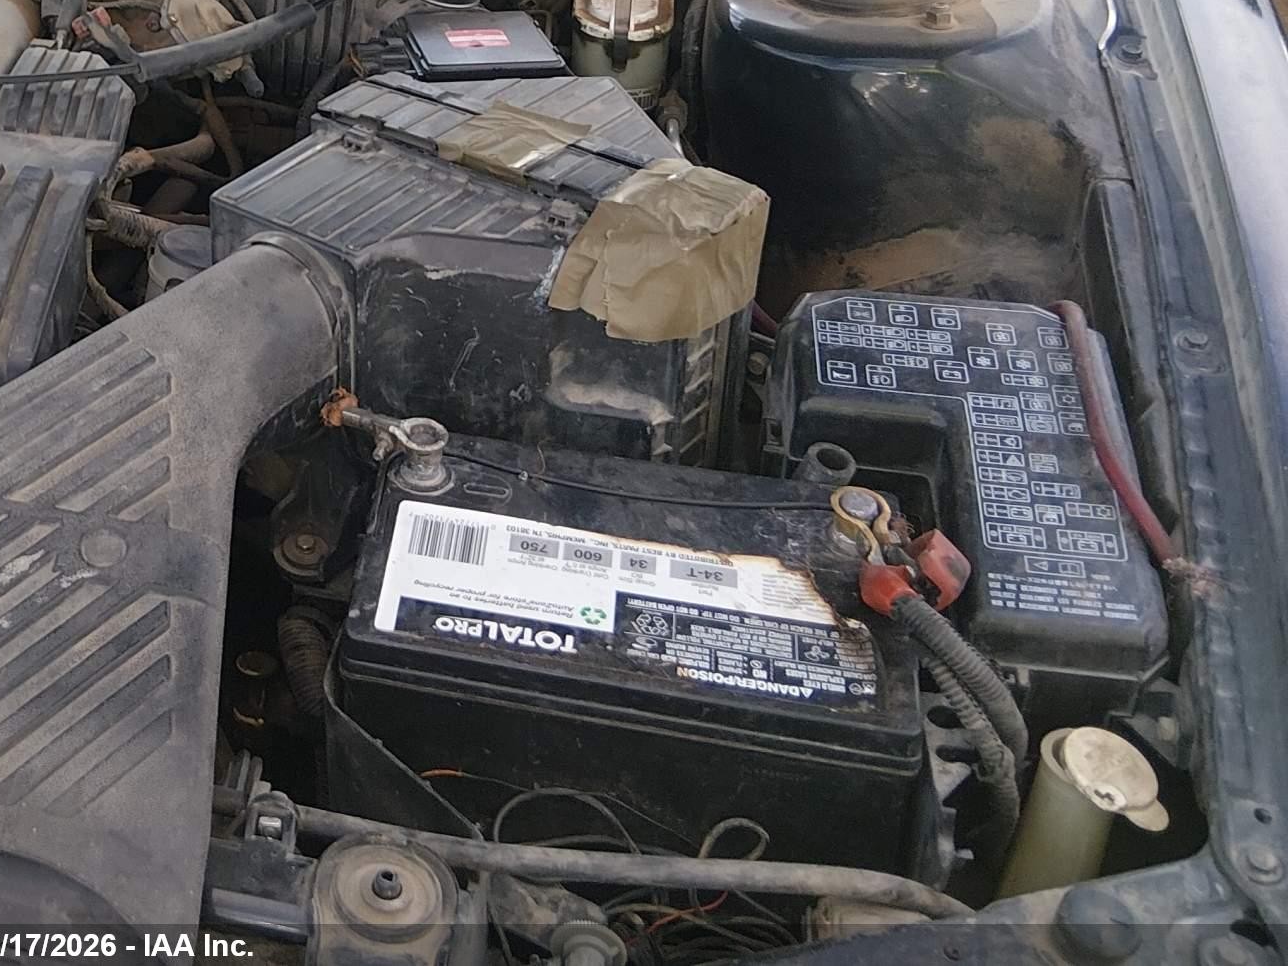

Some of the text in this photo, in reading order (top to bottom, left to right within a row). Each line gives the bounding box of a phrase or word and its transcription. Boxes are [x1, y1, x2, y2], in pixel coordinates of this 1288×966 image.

[505, 525, 530, 534] 38103
[519, 539, 548, 553] 750
[641, 547, 662, 555] BEST
[573, 548, 602, 561] 600
[629, 558, 647, 569] 34
[686, 567, 723, 581] 34-T
[434, 614, 578, 653] TOTALPRO
